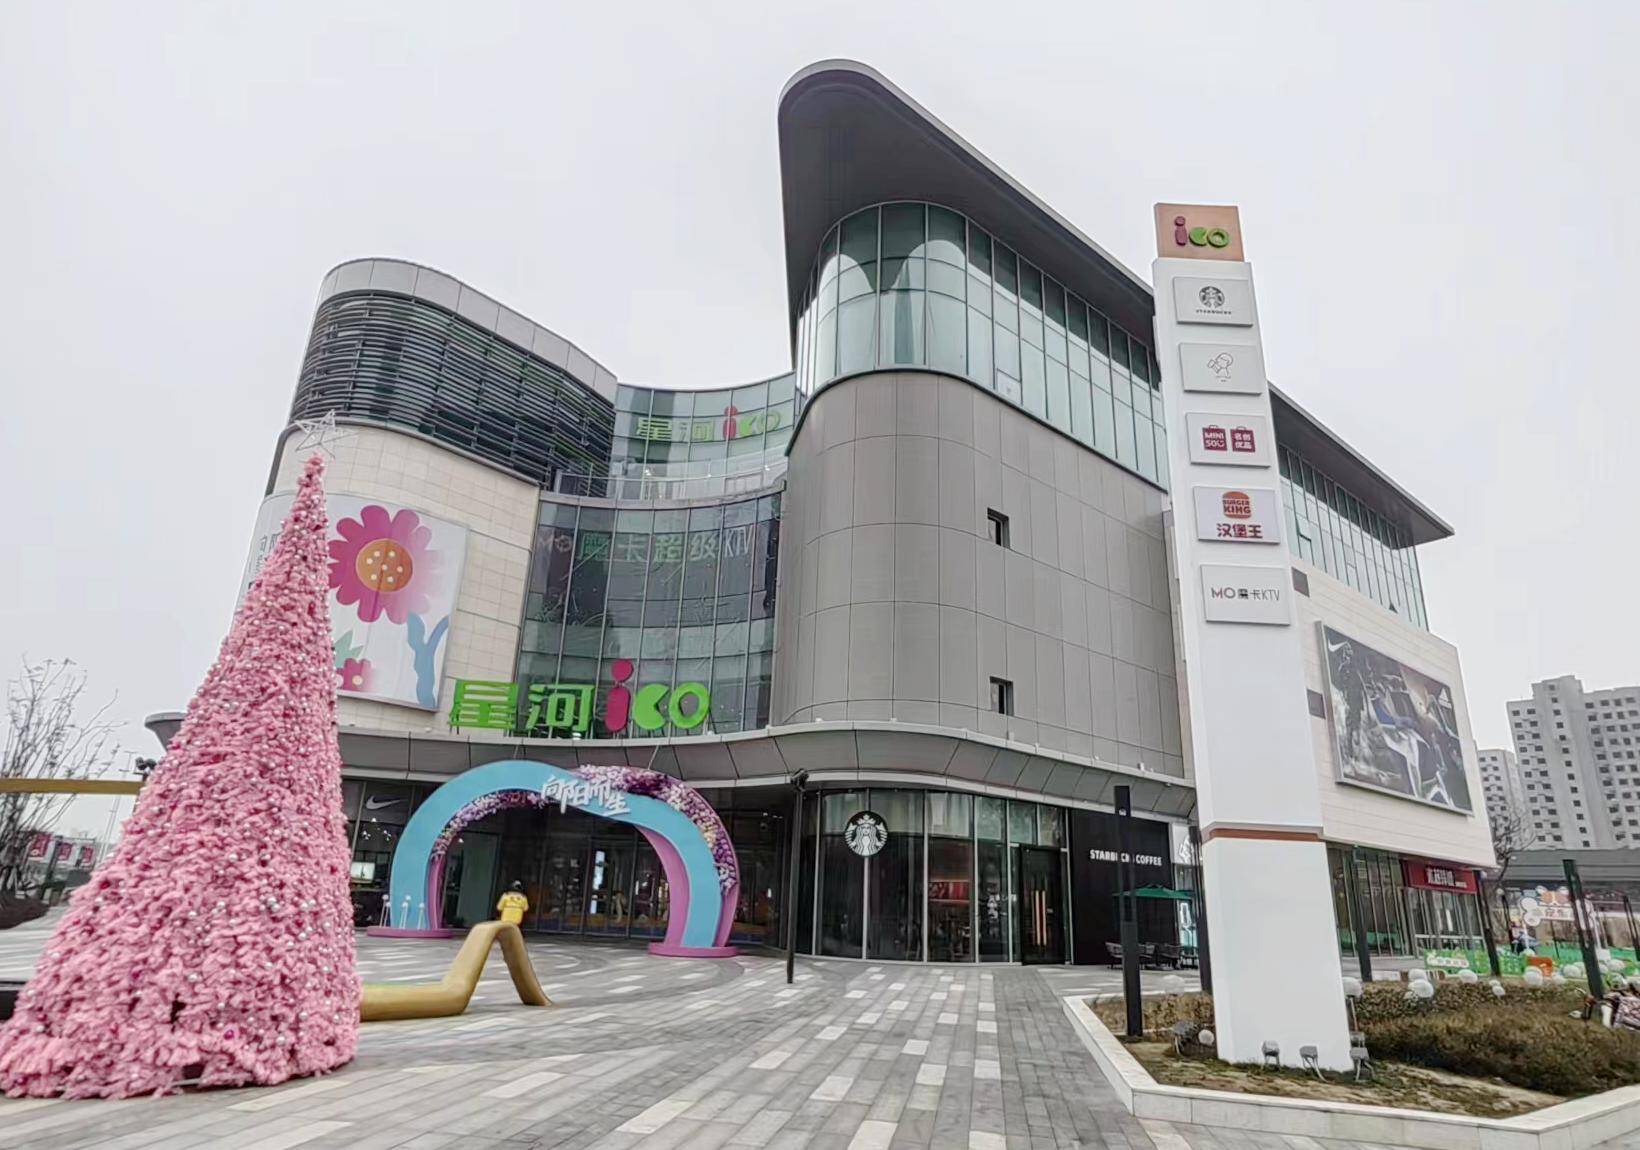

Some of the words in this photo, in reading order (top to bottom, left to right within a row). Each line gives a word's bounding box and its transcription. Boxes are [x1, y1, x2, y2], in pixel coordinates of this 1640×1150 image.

[1204, 432, 1225, 440] MINI
[1223, 505, 1251, 514] KING
[1216, 523, 1263, 539] 汉堡王
[540, 774, 631, 817] 向阳而生
[1089, 849, 1134, 864] STARBCK
[1135, 854, 1163, 867] COFFEE
